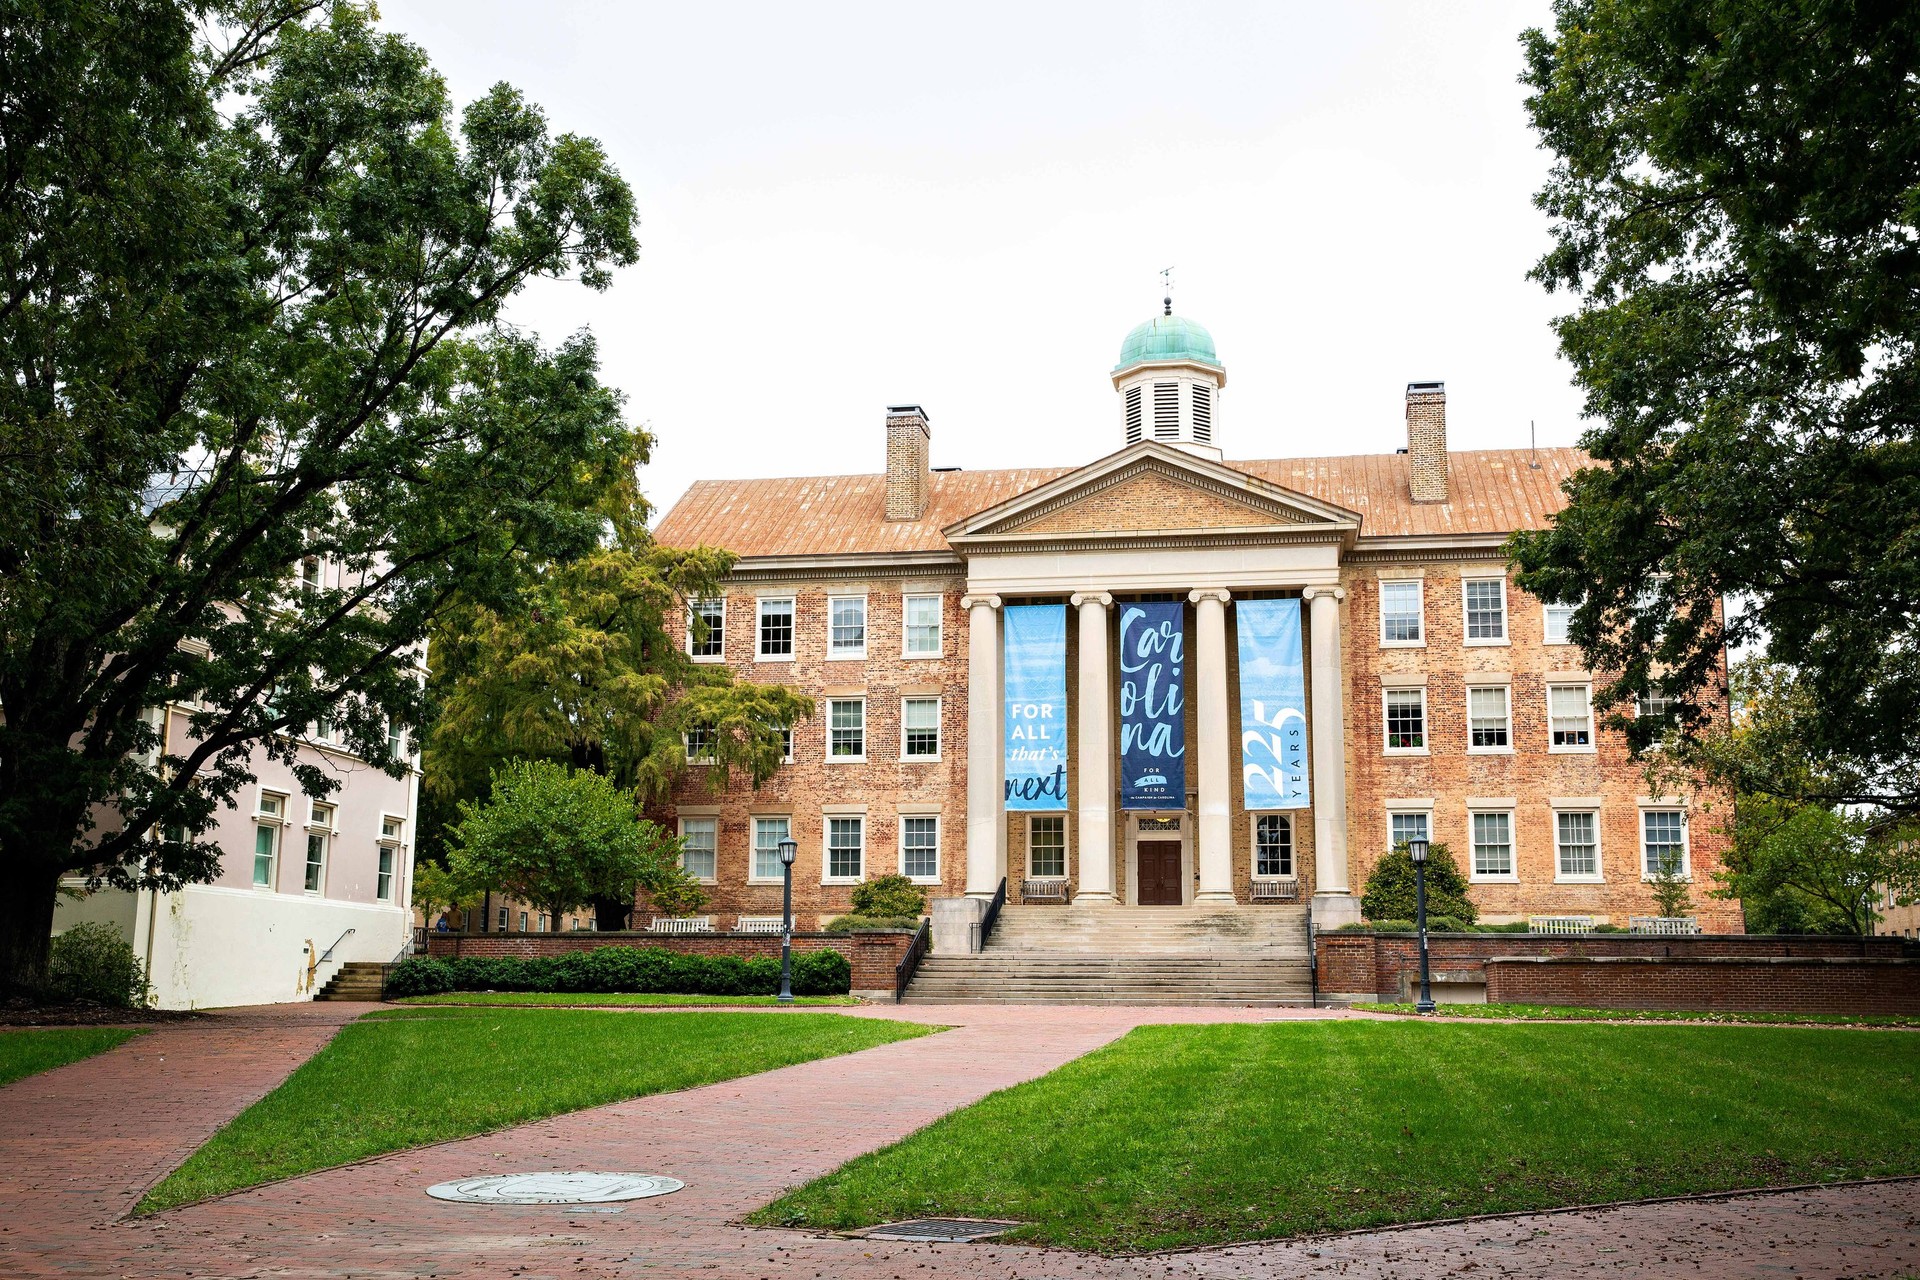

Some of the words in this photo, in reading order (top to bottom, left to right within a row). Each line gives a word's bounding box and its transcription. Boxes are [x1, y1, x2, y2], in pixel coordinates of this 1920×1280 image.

[1012, 704, 1053, 719] FOR
[1011, 725, 1050, 740] ALL
[1242, 699, 1306, 798] 225
[1005, 764, 1068, 800] next
[1290, 730, 1302, 798] YEARS
